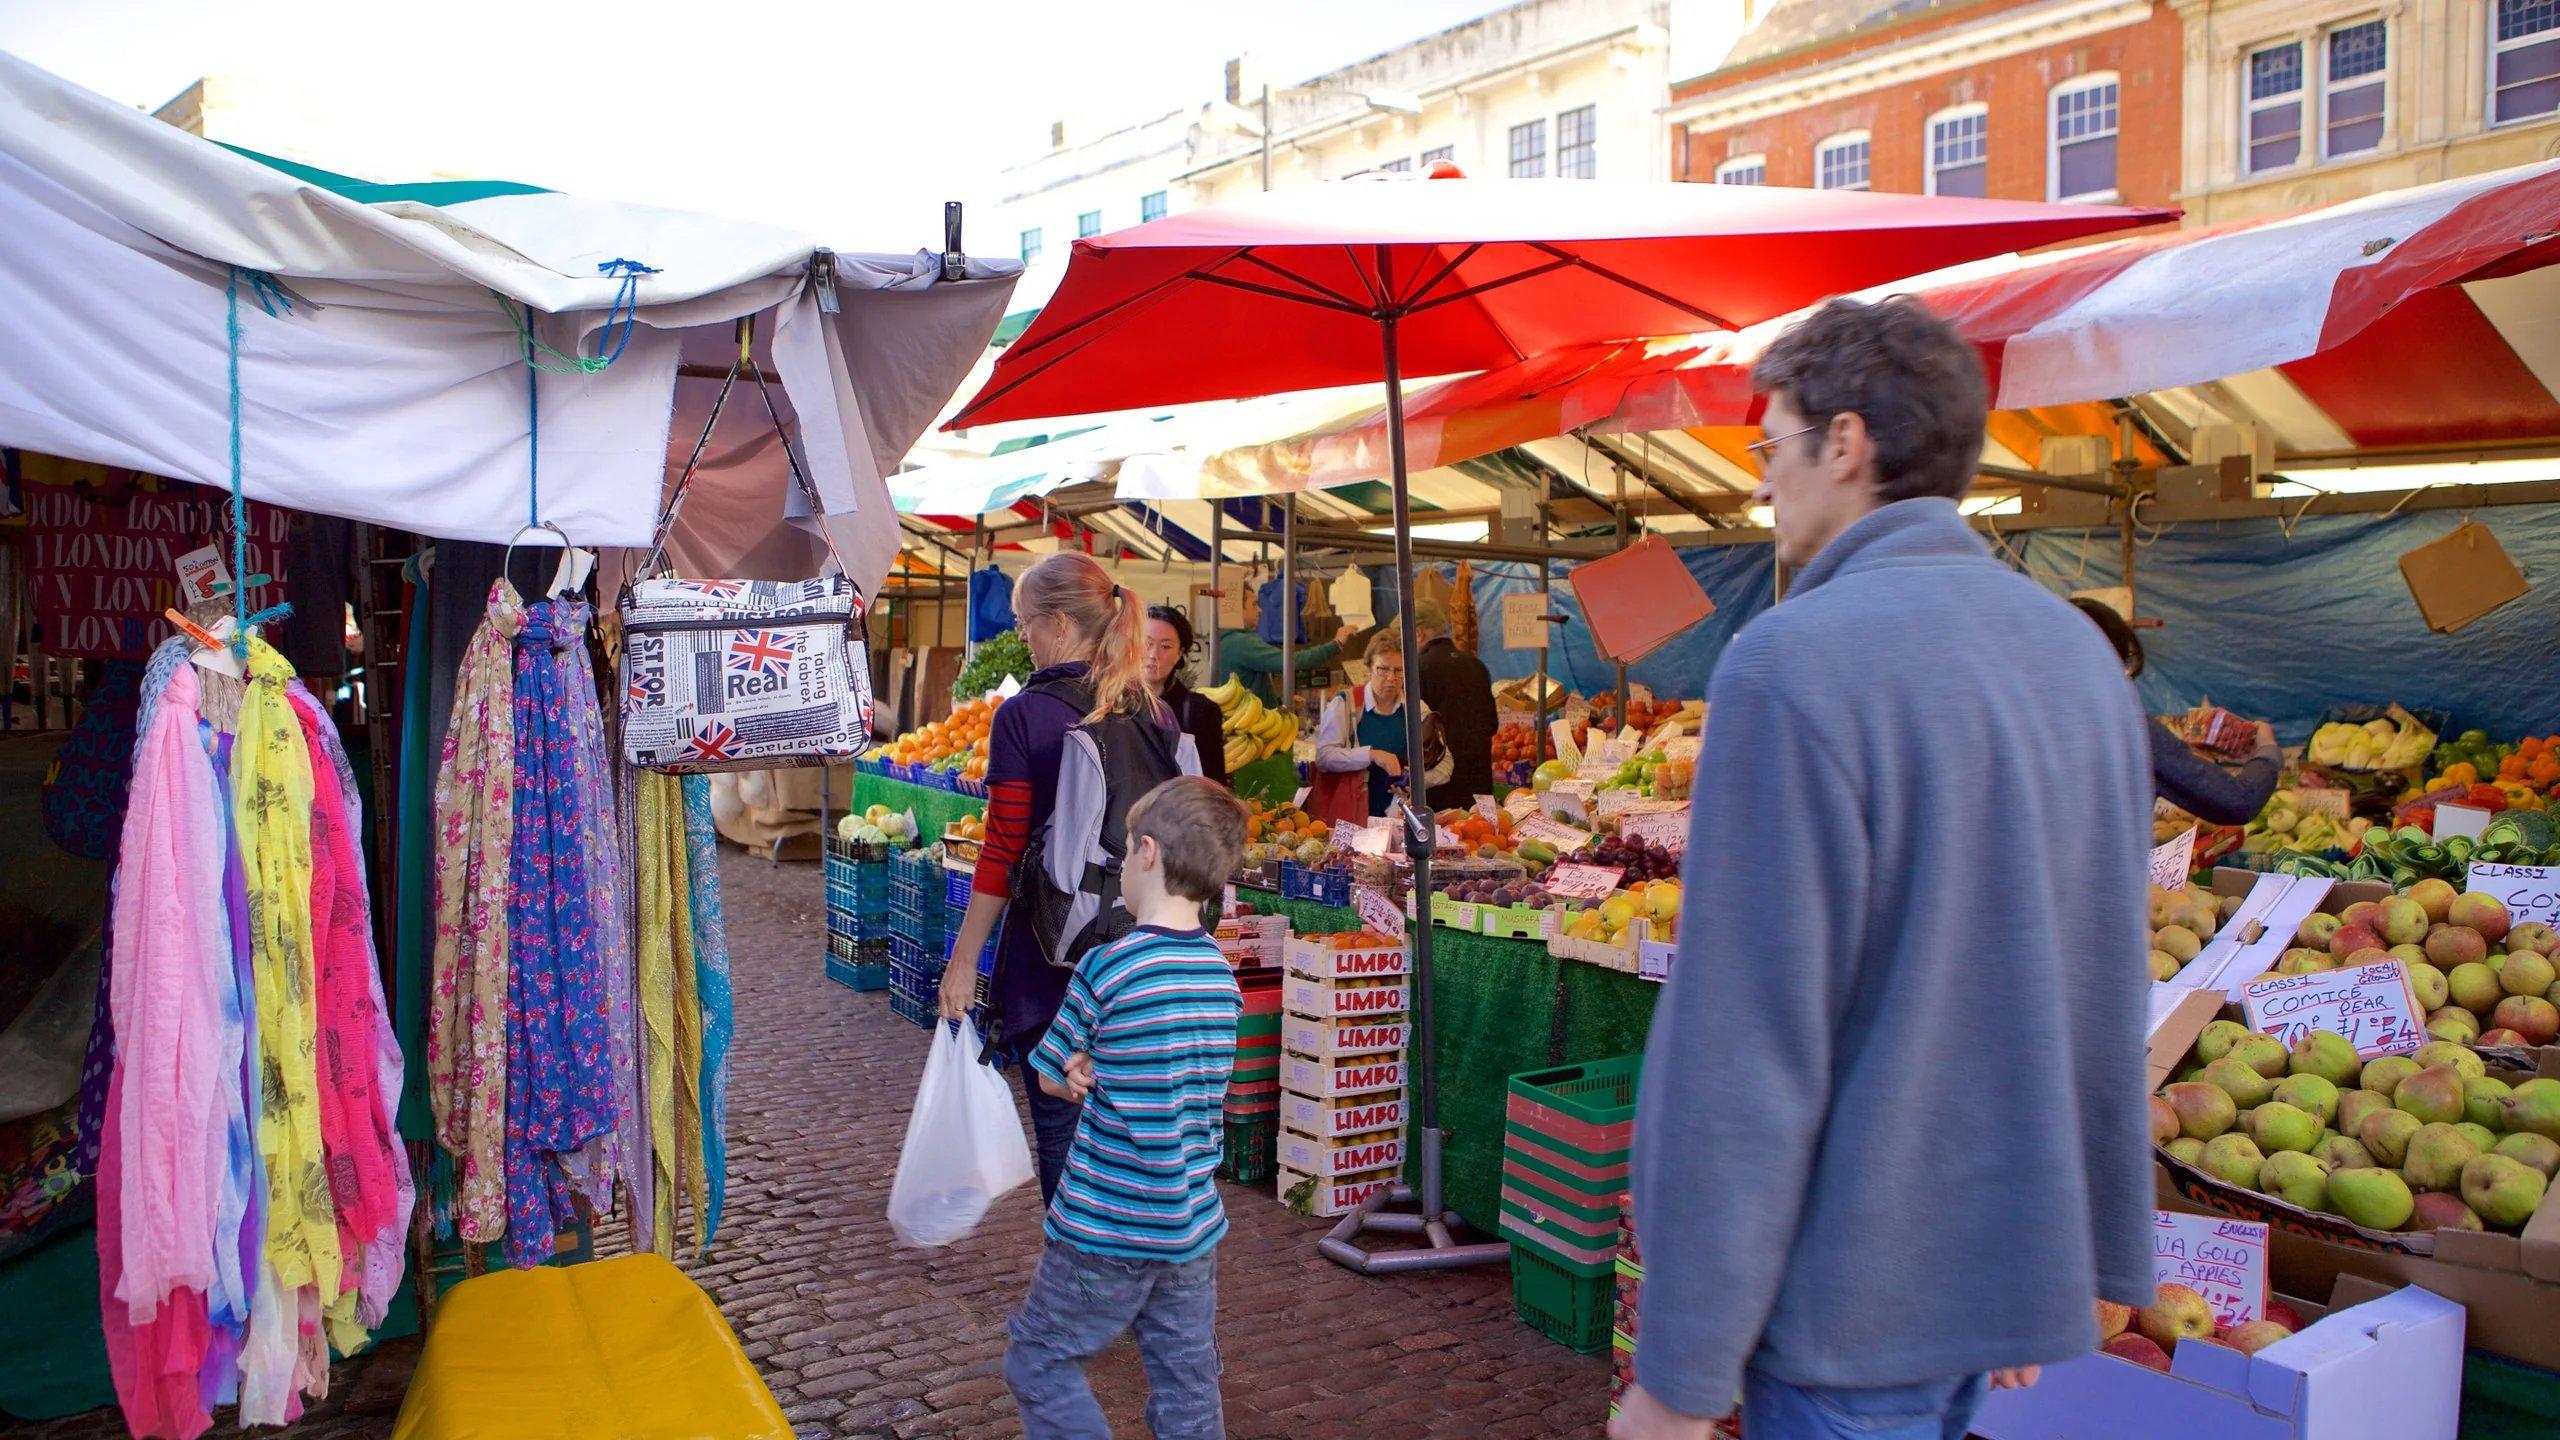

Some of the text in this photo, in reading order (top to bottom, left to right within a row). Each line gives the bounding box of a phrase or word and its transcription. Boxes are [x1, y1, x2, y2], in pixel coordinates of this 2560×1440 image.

[646, 667, 665, 707] FOR
[728, 674, 788, 699] Real
[813, 652, 828, 698] taking
[797, 732, 848, 750] Going
[1336, 952, 1402, 973] LIMBO
[2361, 962, 2397, 975] LOCAL
[1335, 989, 1400, 1012] LIMBO
[2263, 986, 2362, 1017] COMICE
[2339, 996, 2388, 1017] PEAR
[1338, 1026, 1401, 1048] LIMBO
[1335, 1065, 1398, 1089] LIMBO
[1335, 1103, 1399, 1132] LIMBO
[1334, 1142, 1398, 1171] LIMBO
[1334, 1181, 1395, 1208] LIM
[2196, 1241, 2248, 1266] GOLD
